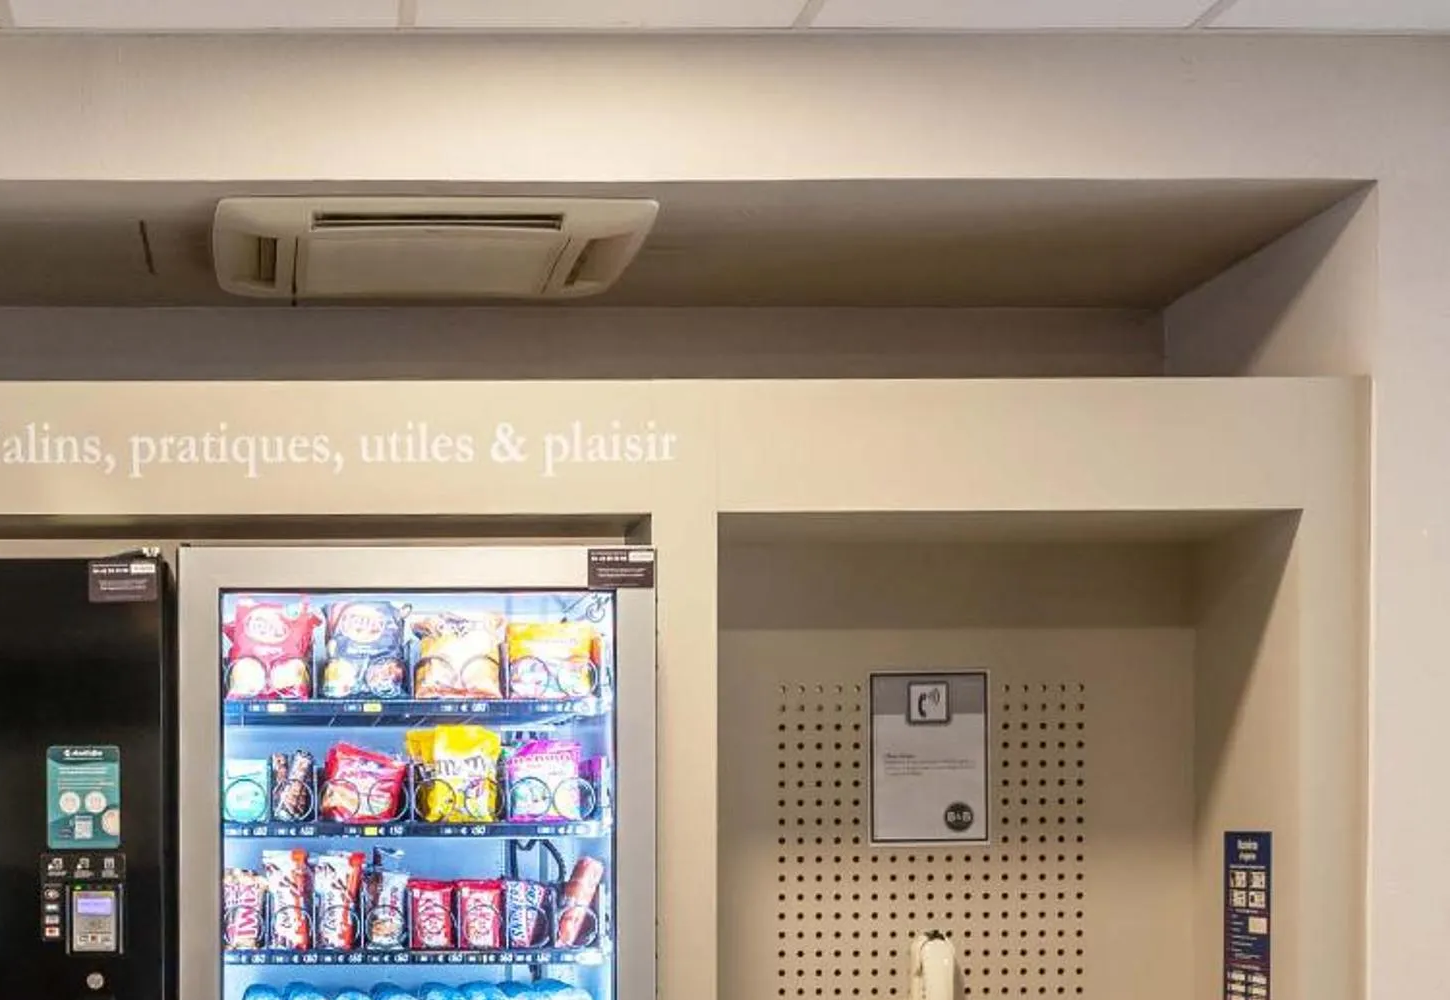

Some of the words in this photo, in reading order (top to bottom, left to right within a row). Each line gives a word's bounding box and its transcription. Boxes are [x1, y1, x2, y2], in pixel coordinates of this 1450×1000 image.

[127, 422, 346, 478] pratiques,
[358, 420, 476, 464] utiles
[489, 422, 528, 465] &
[539, 420, 679, 478] plaisir
